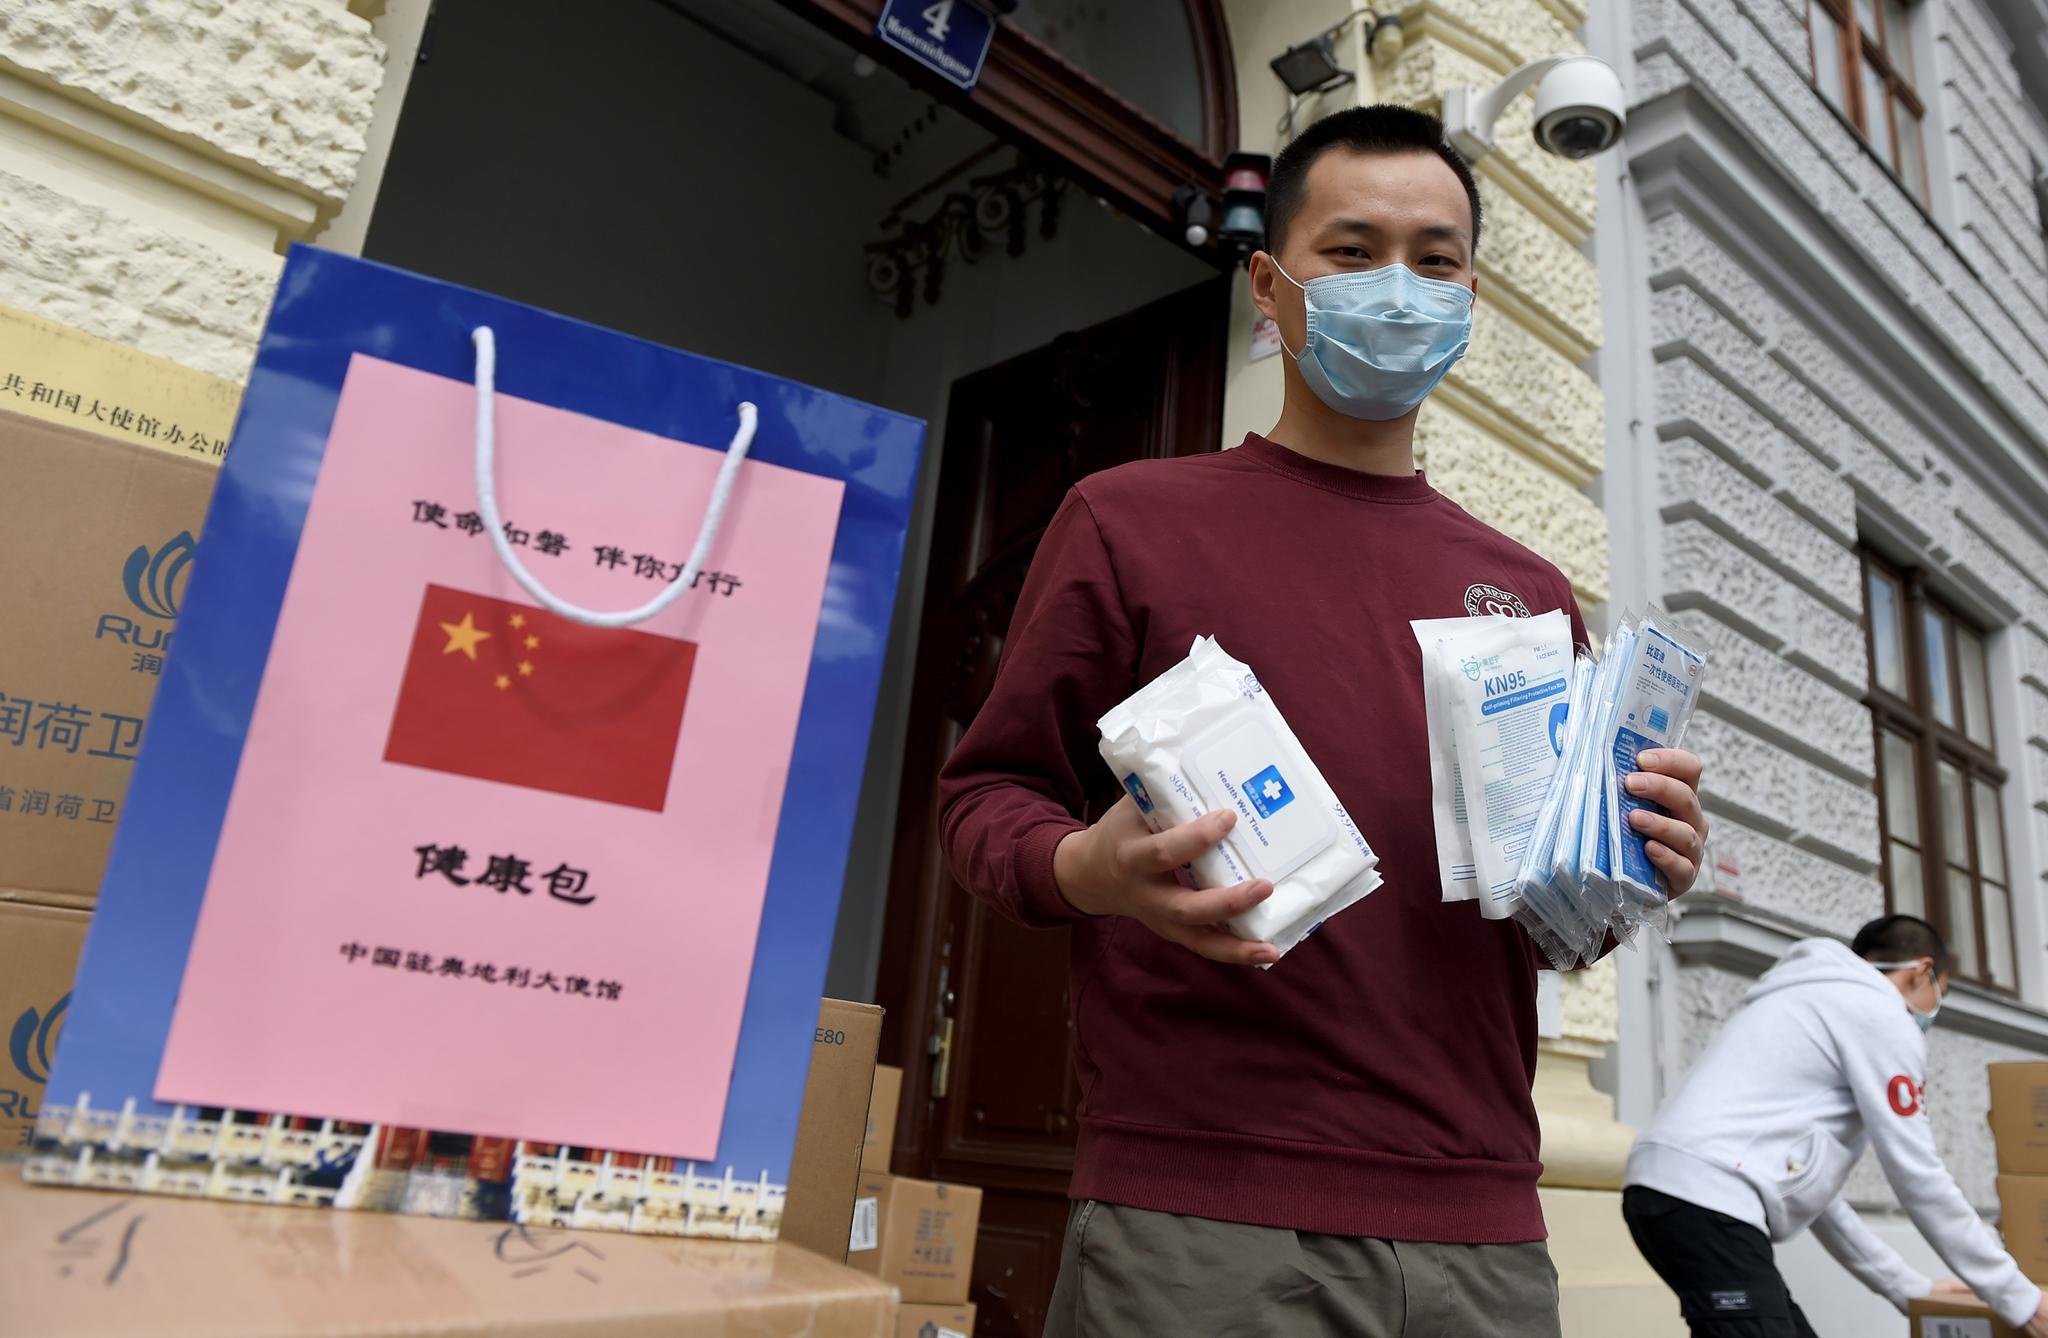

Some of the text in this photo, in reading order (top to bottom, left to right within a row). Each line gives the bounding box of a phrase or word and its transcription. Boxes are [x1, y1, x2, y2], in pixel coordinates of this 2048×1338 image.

[921, 0, 955, 42] 4
[1484, 587, 1512, 601] NEW
[1645, 643, 1666, 664] 比亚迪
[1484, 670, 1527, 697] KN95
[1217, 770, 1238, 800] Health
[1236, 798, 1251, 818] Wet
[1249, 818, 1269, 847] Tissue
[415, 842, 596, 906] 健康包
[340, 942, 623, 1001] 中国驻奥地利大使馆
